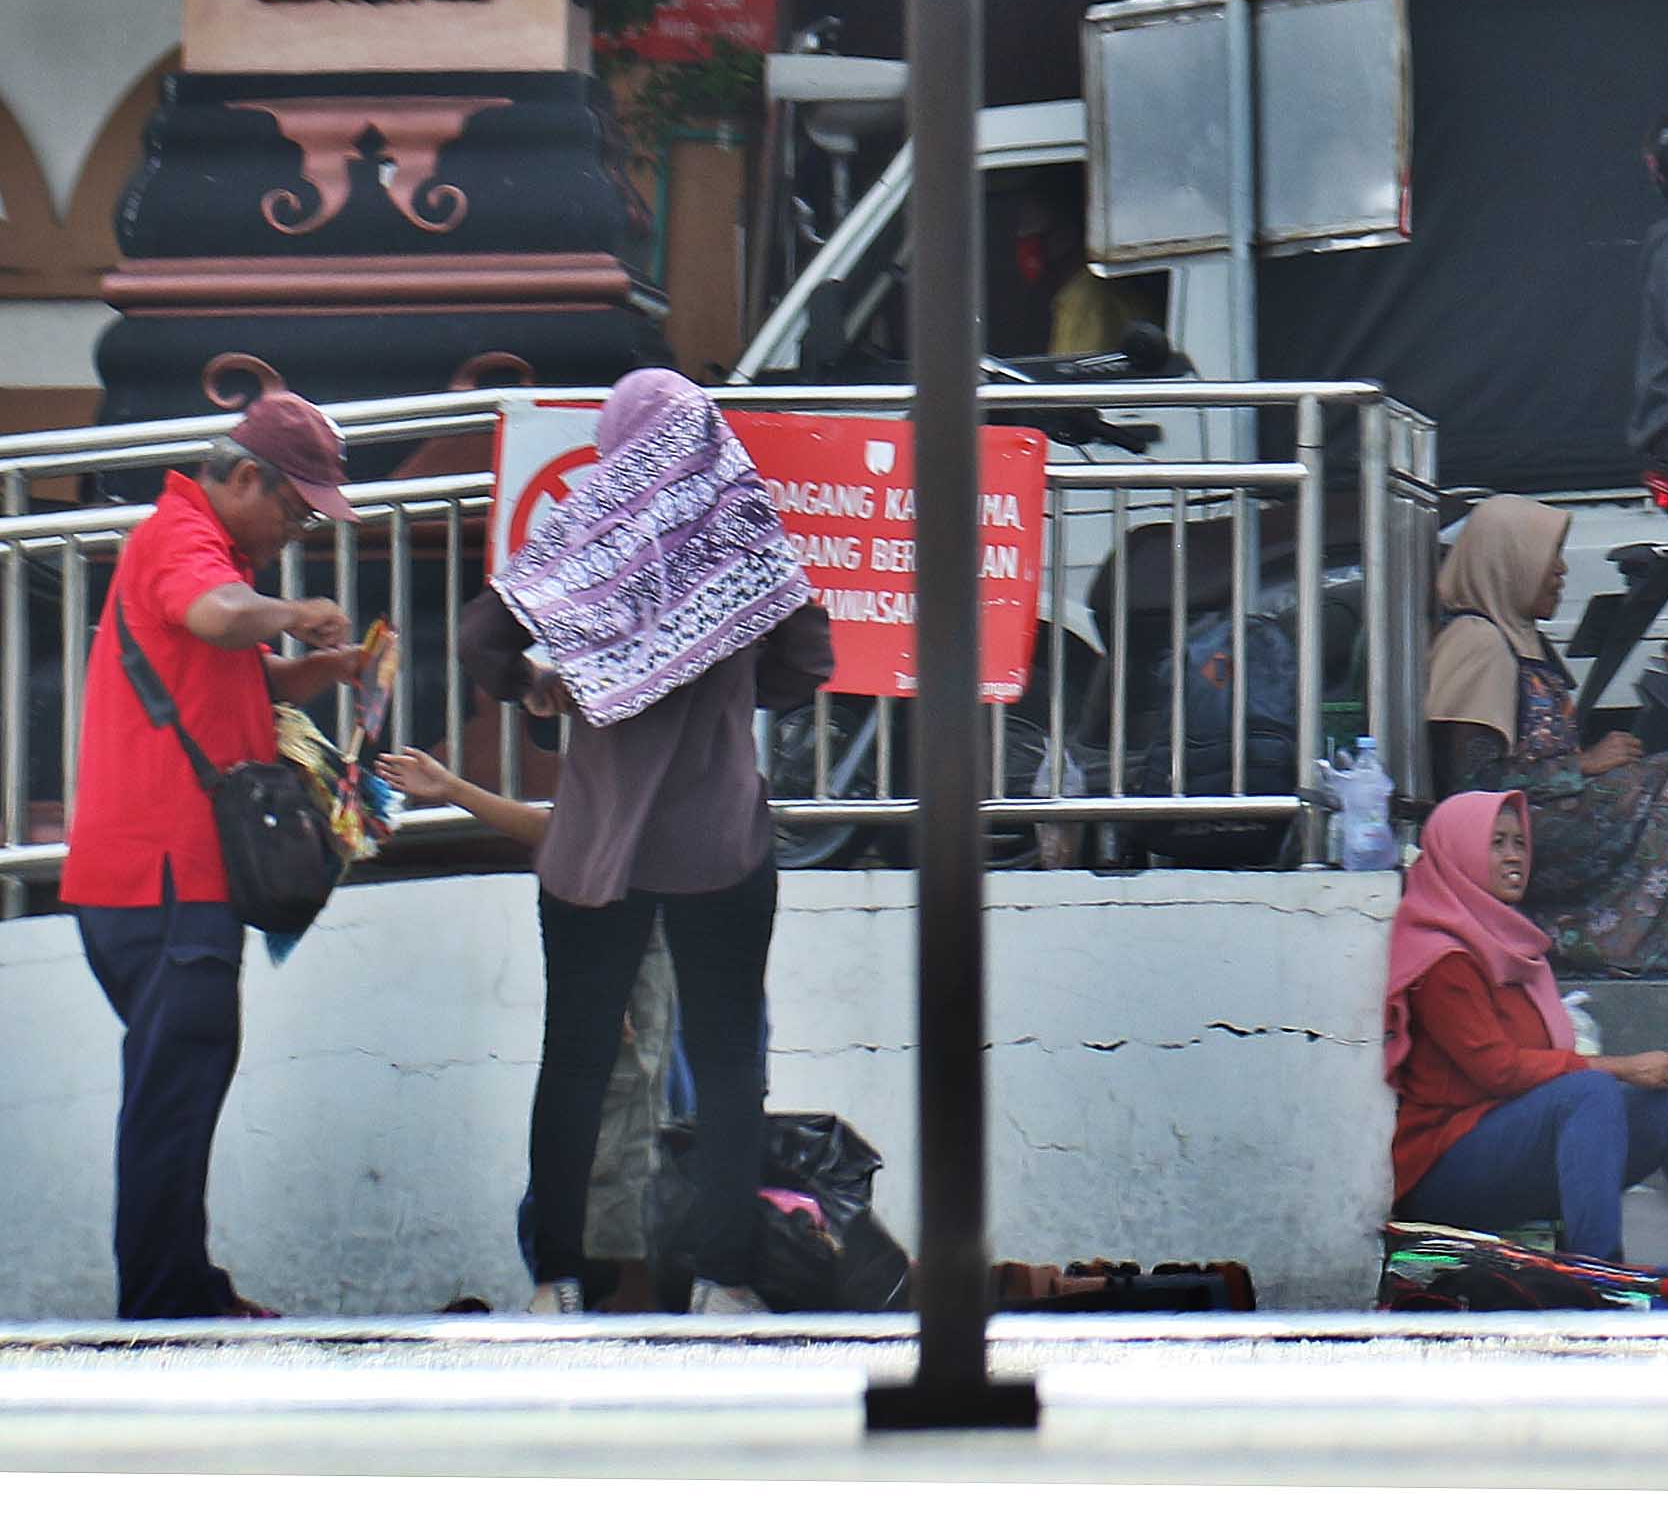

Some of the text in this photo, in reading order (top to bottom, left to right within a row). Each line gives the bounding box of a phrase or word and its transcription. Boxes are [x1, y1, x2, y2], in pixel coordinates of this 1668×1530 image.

[766, 478, 874, 520] DAGANG
[884, 486, 918, 521] KA
[788, 533, 862, 570] RANG
